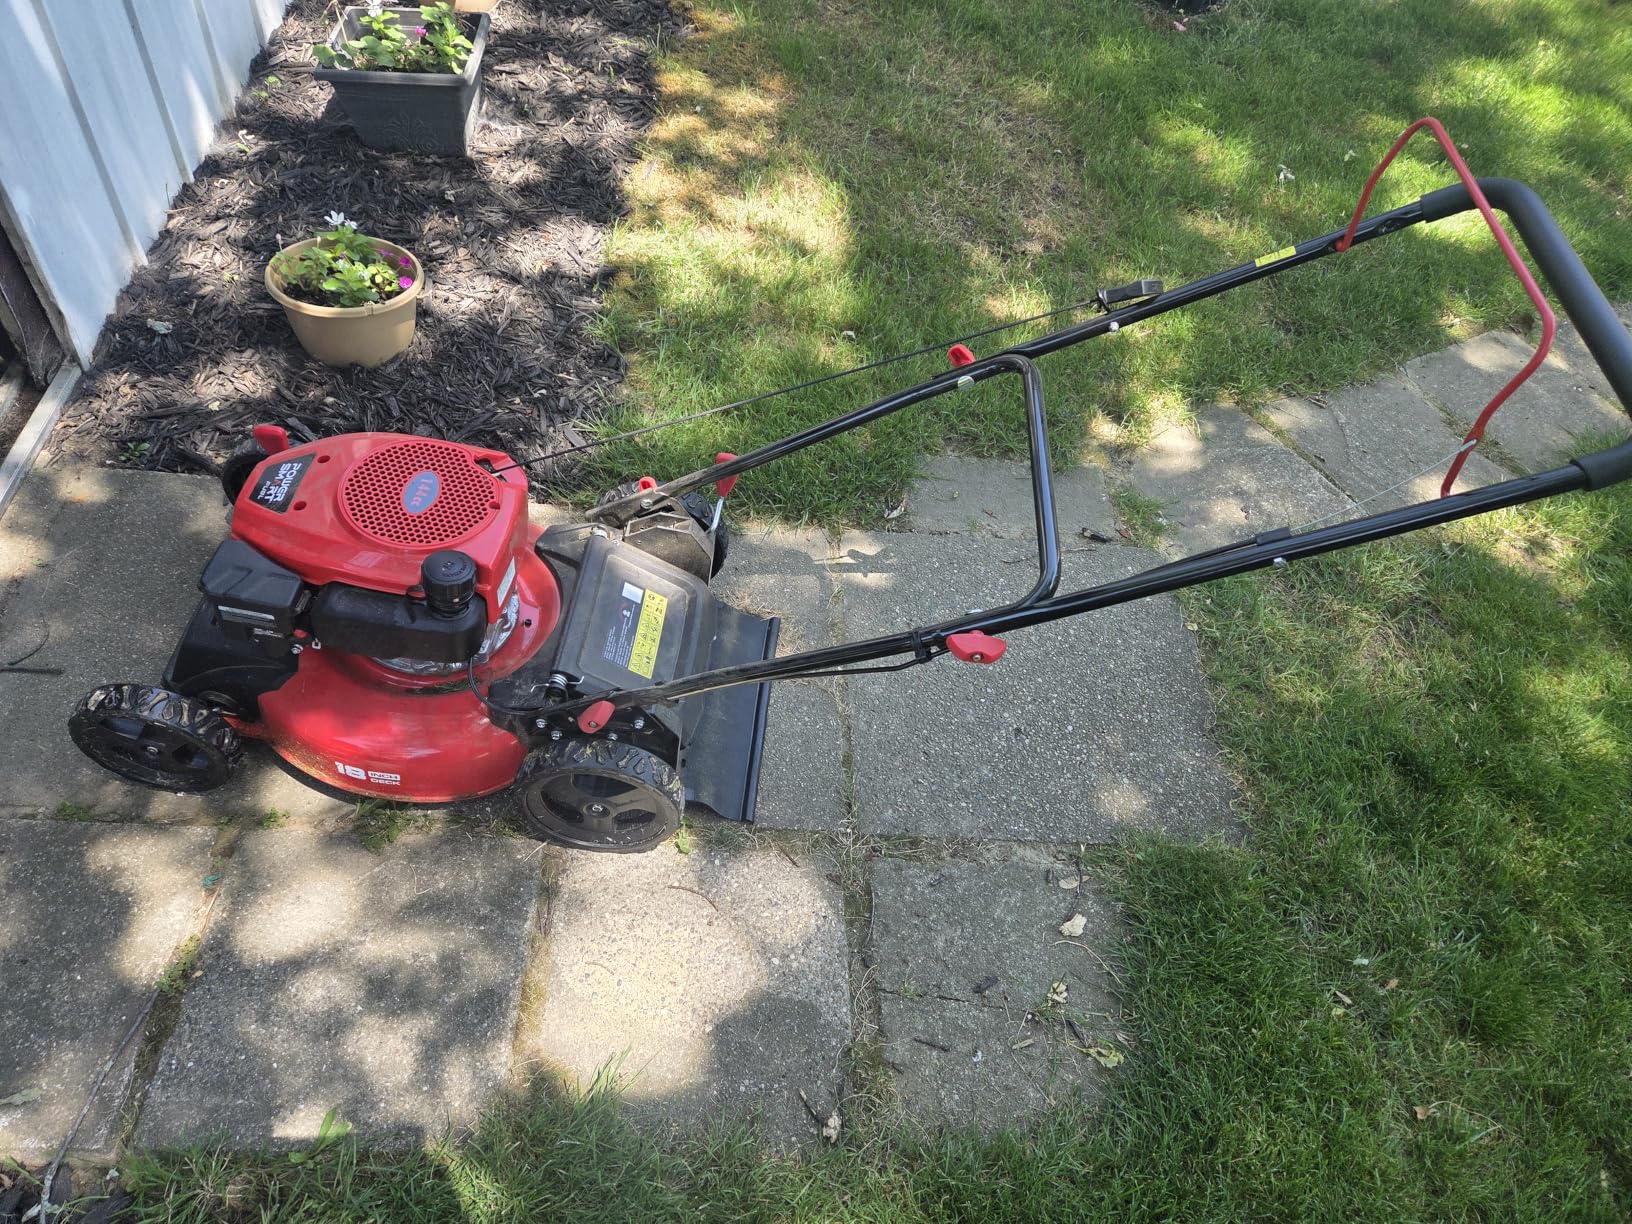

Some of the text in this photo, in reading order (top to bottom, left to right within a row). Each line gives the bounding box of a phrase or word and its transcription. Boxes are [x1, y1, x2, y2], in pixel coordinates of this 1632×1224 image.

[264, 463, 288, 504] SMART
[273, 462, 302, 502] POWER
[334, 761, 366, 780] 18
[369, 771, 399, 780] INCH
[370, 778, 401, 786] DECK
